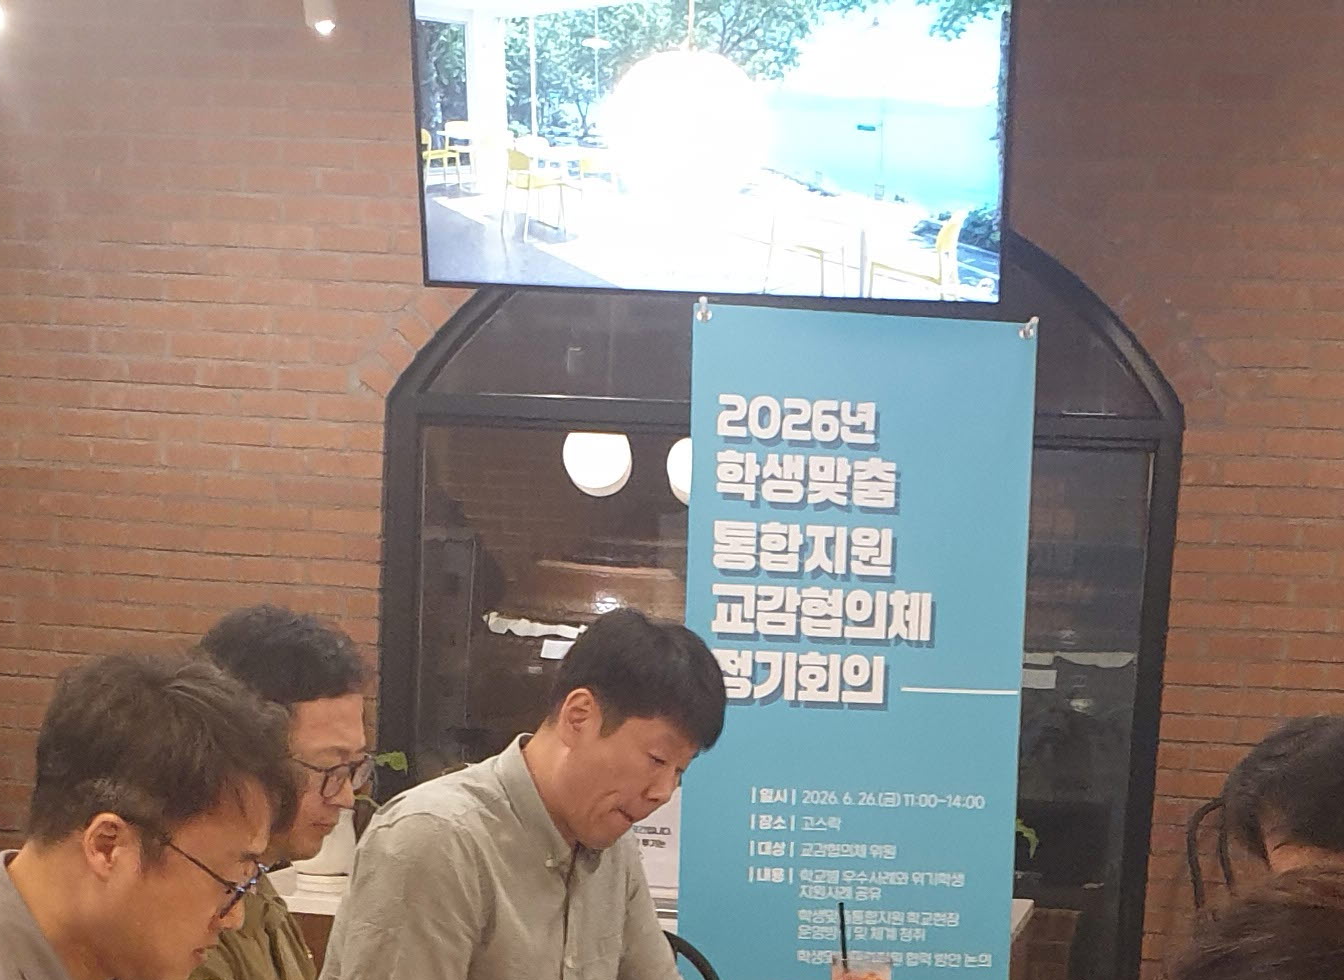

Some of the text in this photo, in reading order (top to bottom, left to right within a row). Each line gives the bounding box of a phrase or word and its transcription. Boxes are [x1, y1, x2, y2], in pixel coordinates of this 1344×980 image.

[716, 393, 876, 444] 2026년
[715, 449, 896, 508] 학생맞춤
[713, 520, 894, 577] 통합지원
[711, 583, 933, 641] 교감협의체
[711, 648, 886, 704] 정기회의
[758, 814, 842, 831] 장소 고스락
[757, 841, 786, 857] 대상
[870, 844, 897, 860] 위원
[855, 886, 882, 901] 공유
[964, 953, 993, 968] 논의
